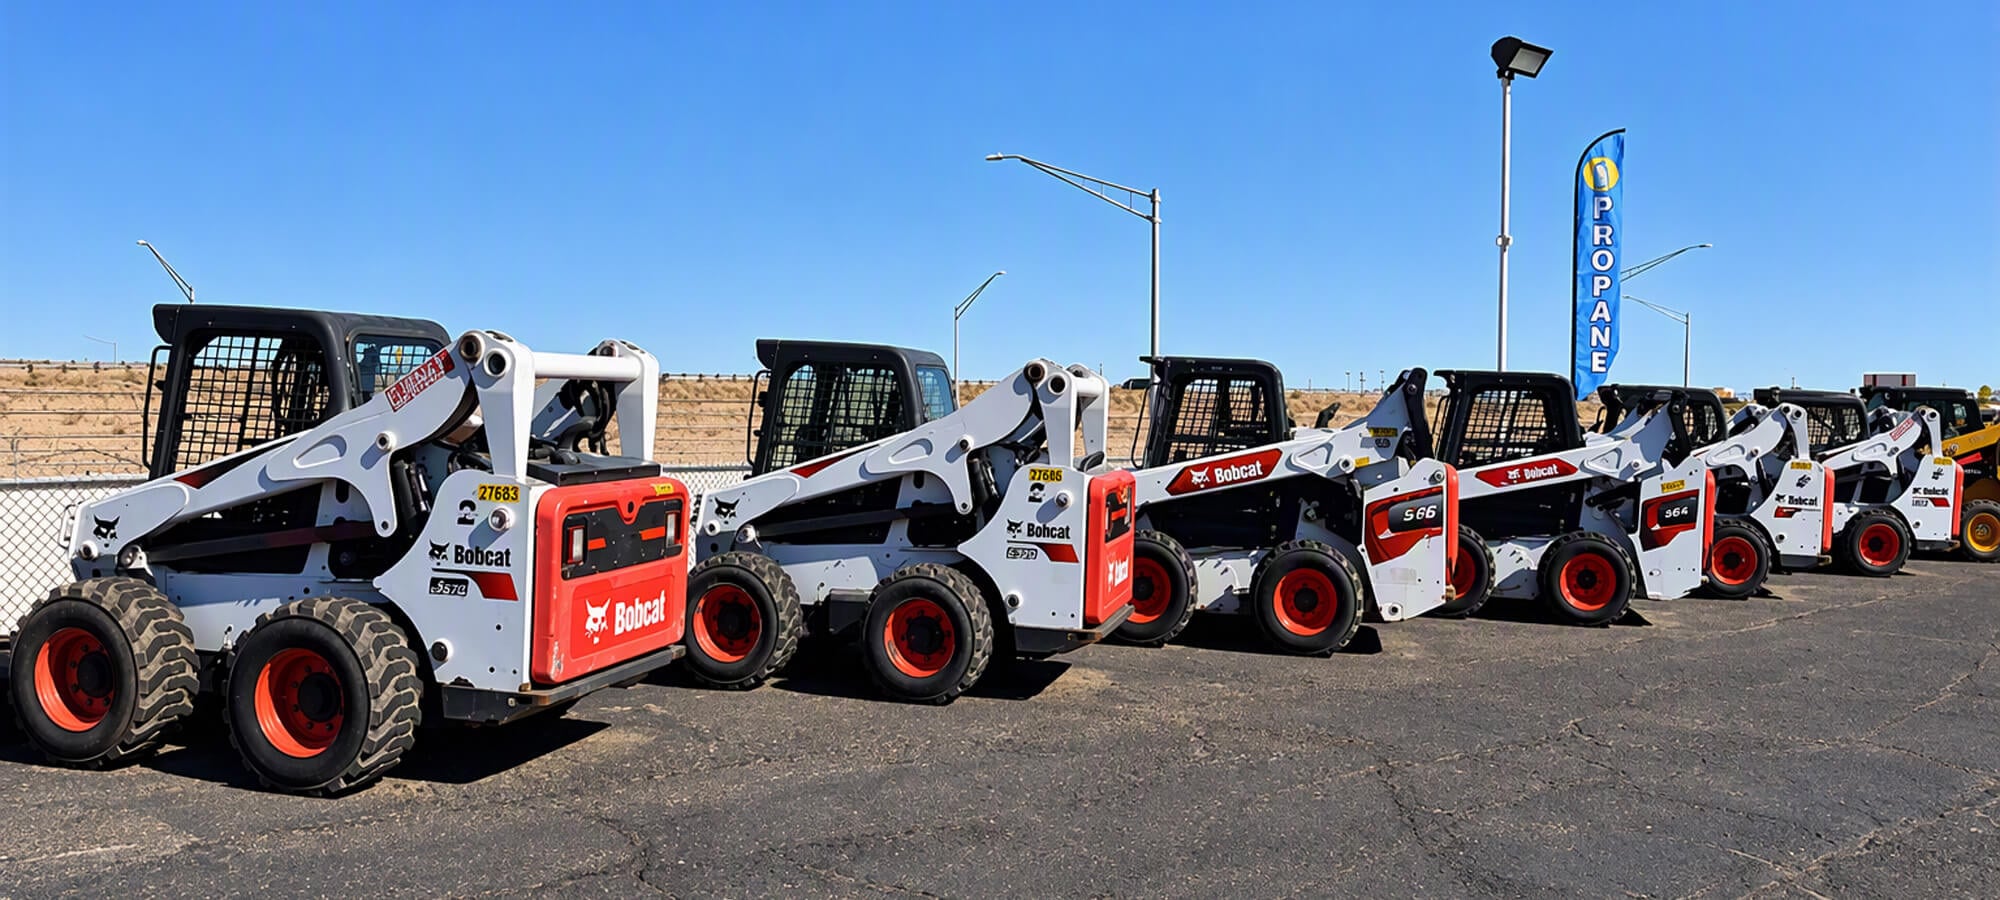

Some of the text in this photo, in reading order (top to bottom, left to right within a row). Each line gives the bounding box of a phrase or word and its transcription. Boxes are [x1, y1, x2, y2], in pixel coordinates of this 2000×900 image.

[1590, 195, 1614, 373] PROPANE
[1214, 460, 1263, 483] Bobcat
[478, 485, 519, 501] 27683
[1403, 505, 1437, 521] S66
[454, 545, 511, 567] Bobcat
[614, 589, 666, 635] Bobcat
